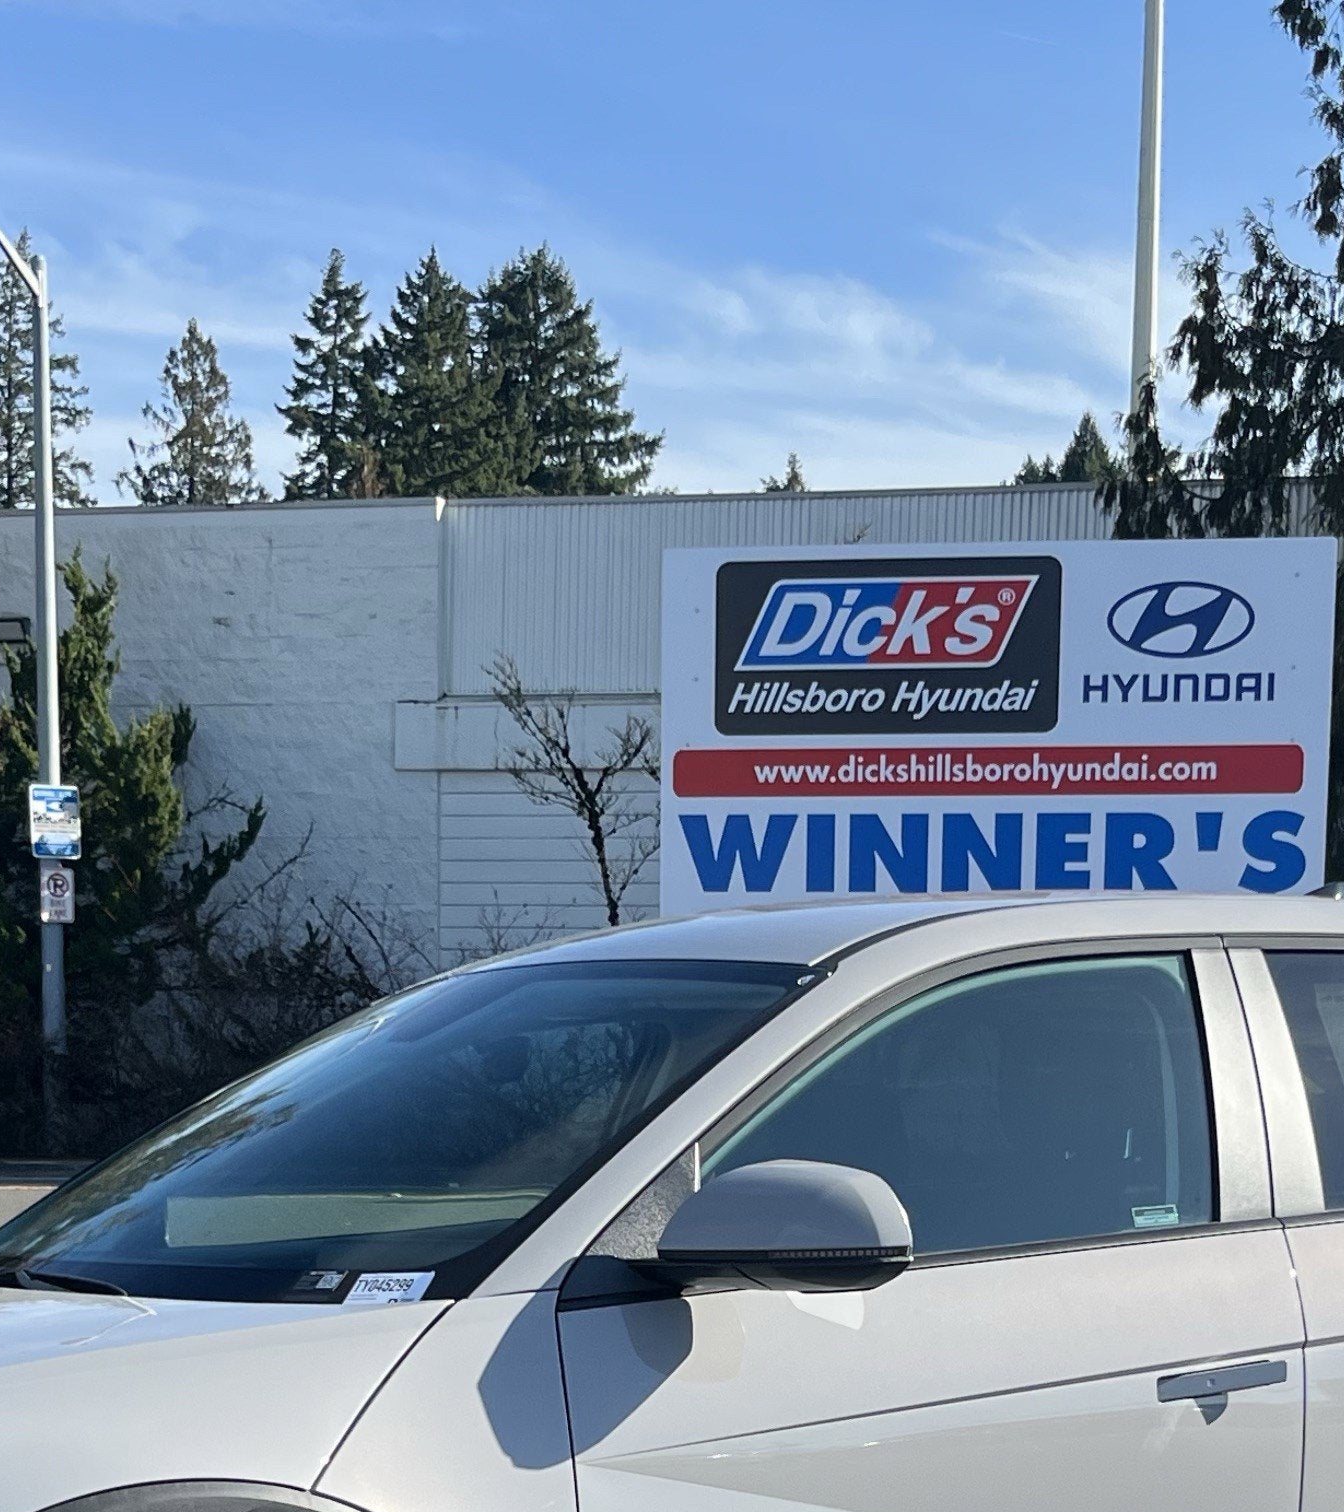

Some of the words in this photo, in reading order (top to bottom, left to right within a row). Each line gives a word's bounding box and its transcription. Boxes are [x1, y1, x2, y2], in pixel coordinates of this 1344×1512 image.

[757, 586, 1000, 657] Dick's
[727, 682, 886, 715] Hillsboro
[891, 679, 1040, 720] Hyundai
[1082, 672, 1276, 704] HYUNDAI
[754, 754, 1217, 790] www.dickshillsborohyundai.com
[678, 809, 1307, 895] WINNER'S
